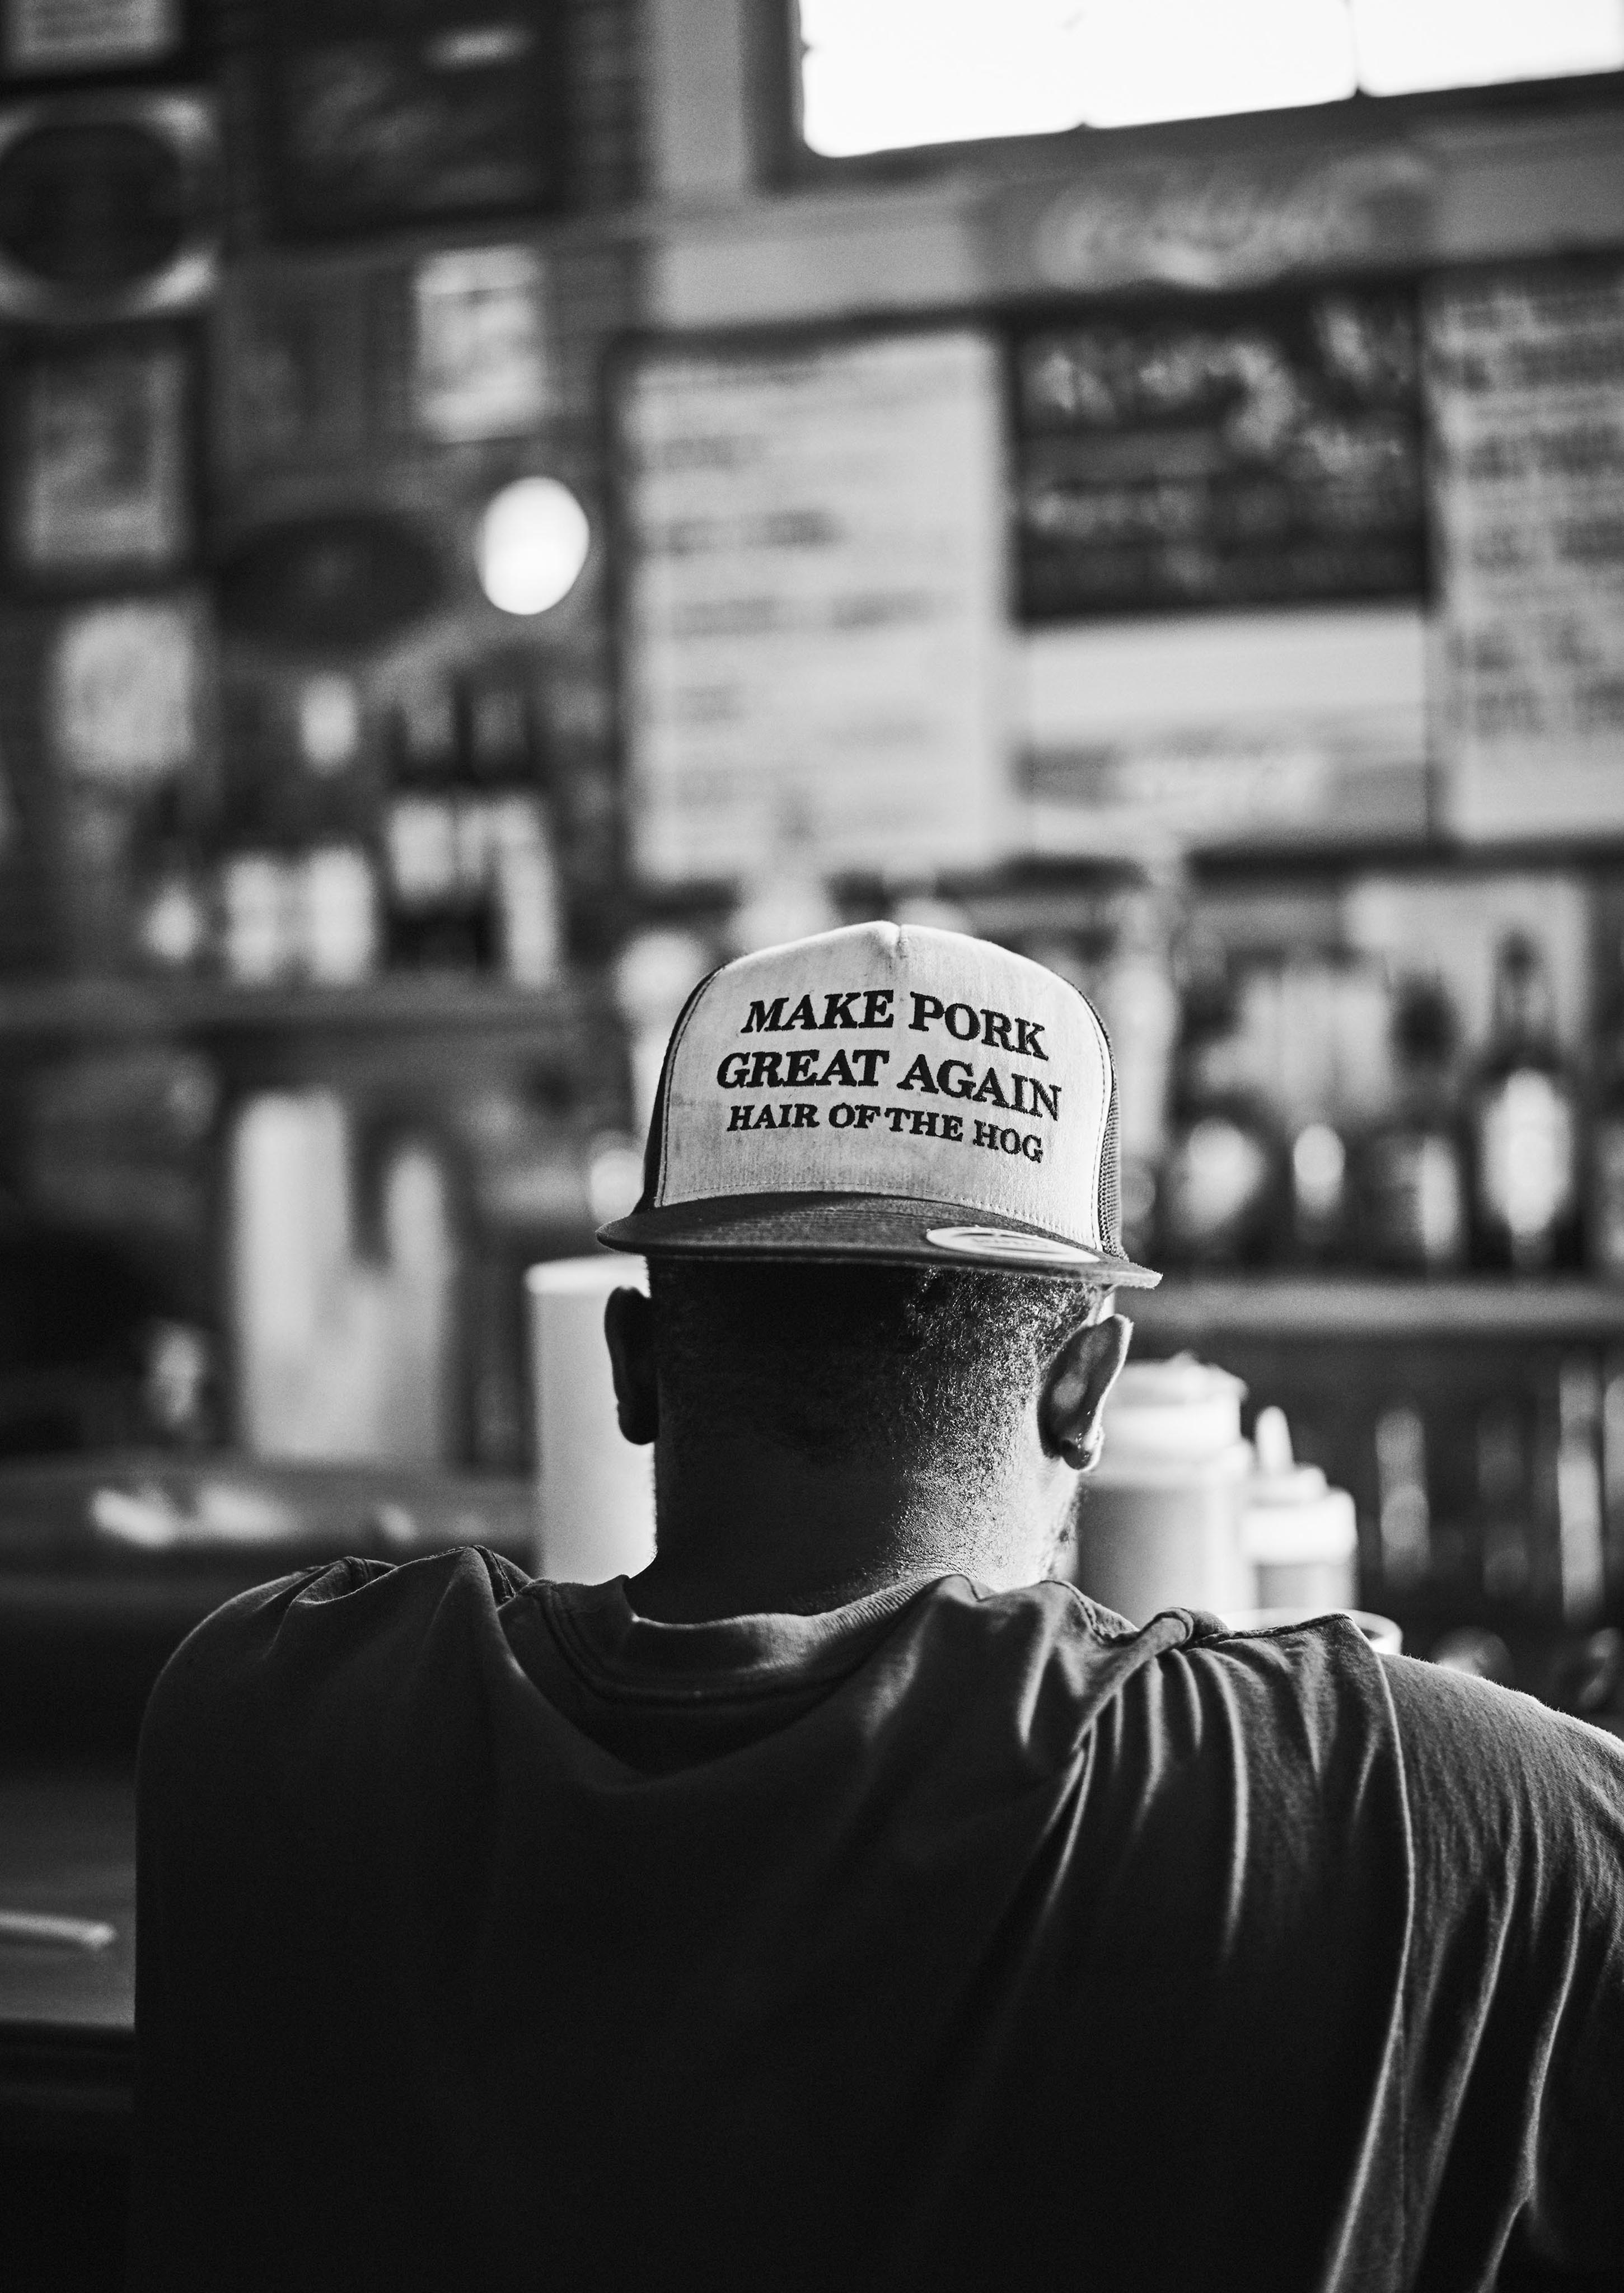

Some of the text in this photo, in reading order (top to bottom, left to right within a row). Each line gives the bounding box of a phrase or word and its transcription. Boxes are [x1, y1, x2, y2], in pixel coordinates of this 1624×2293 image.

[740, 989, 1049, 1061] MAKE PORK
[717, 1049, 1062, 1121] GREAT AGAIN
[726, 1102, 1043, 1163] HAIR OF THE HOG
